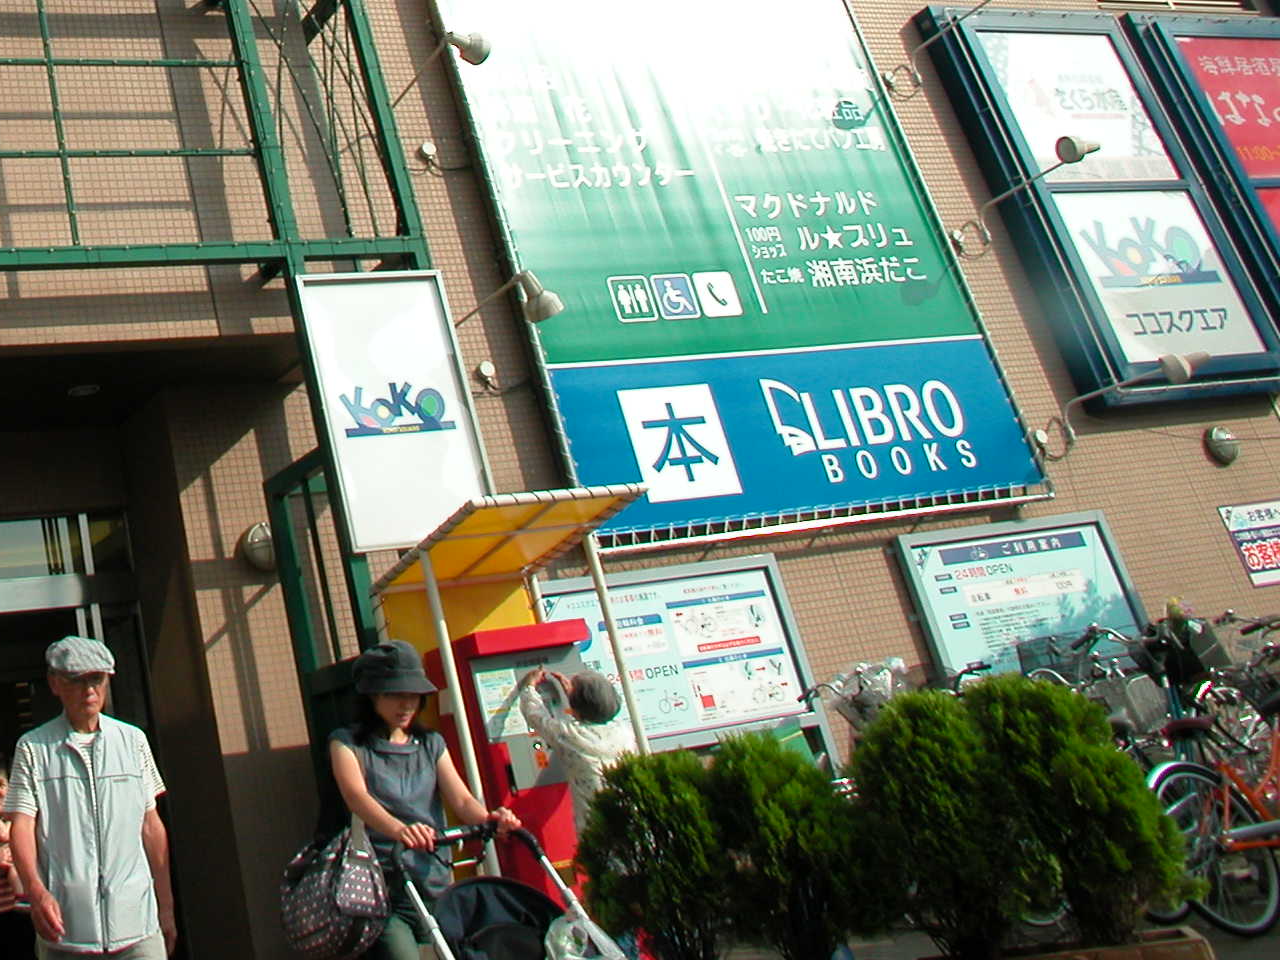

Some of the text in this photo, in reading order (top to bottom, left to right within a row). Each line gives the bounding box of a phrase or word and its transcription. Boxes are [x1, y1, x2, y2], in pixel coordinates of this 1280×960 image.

[734, 190, 880, 219] マクドナルド
[806, 256, 928, 288] 湘南浜だこ
[1125, 307, 1228, 336] ココスクエア
[799, 379, 965, 451] LIBRO
[641, 401, 720, 482] 本
[821, 439, 978, 484] BOOKS
